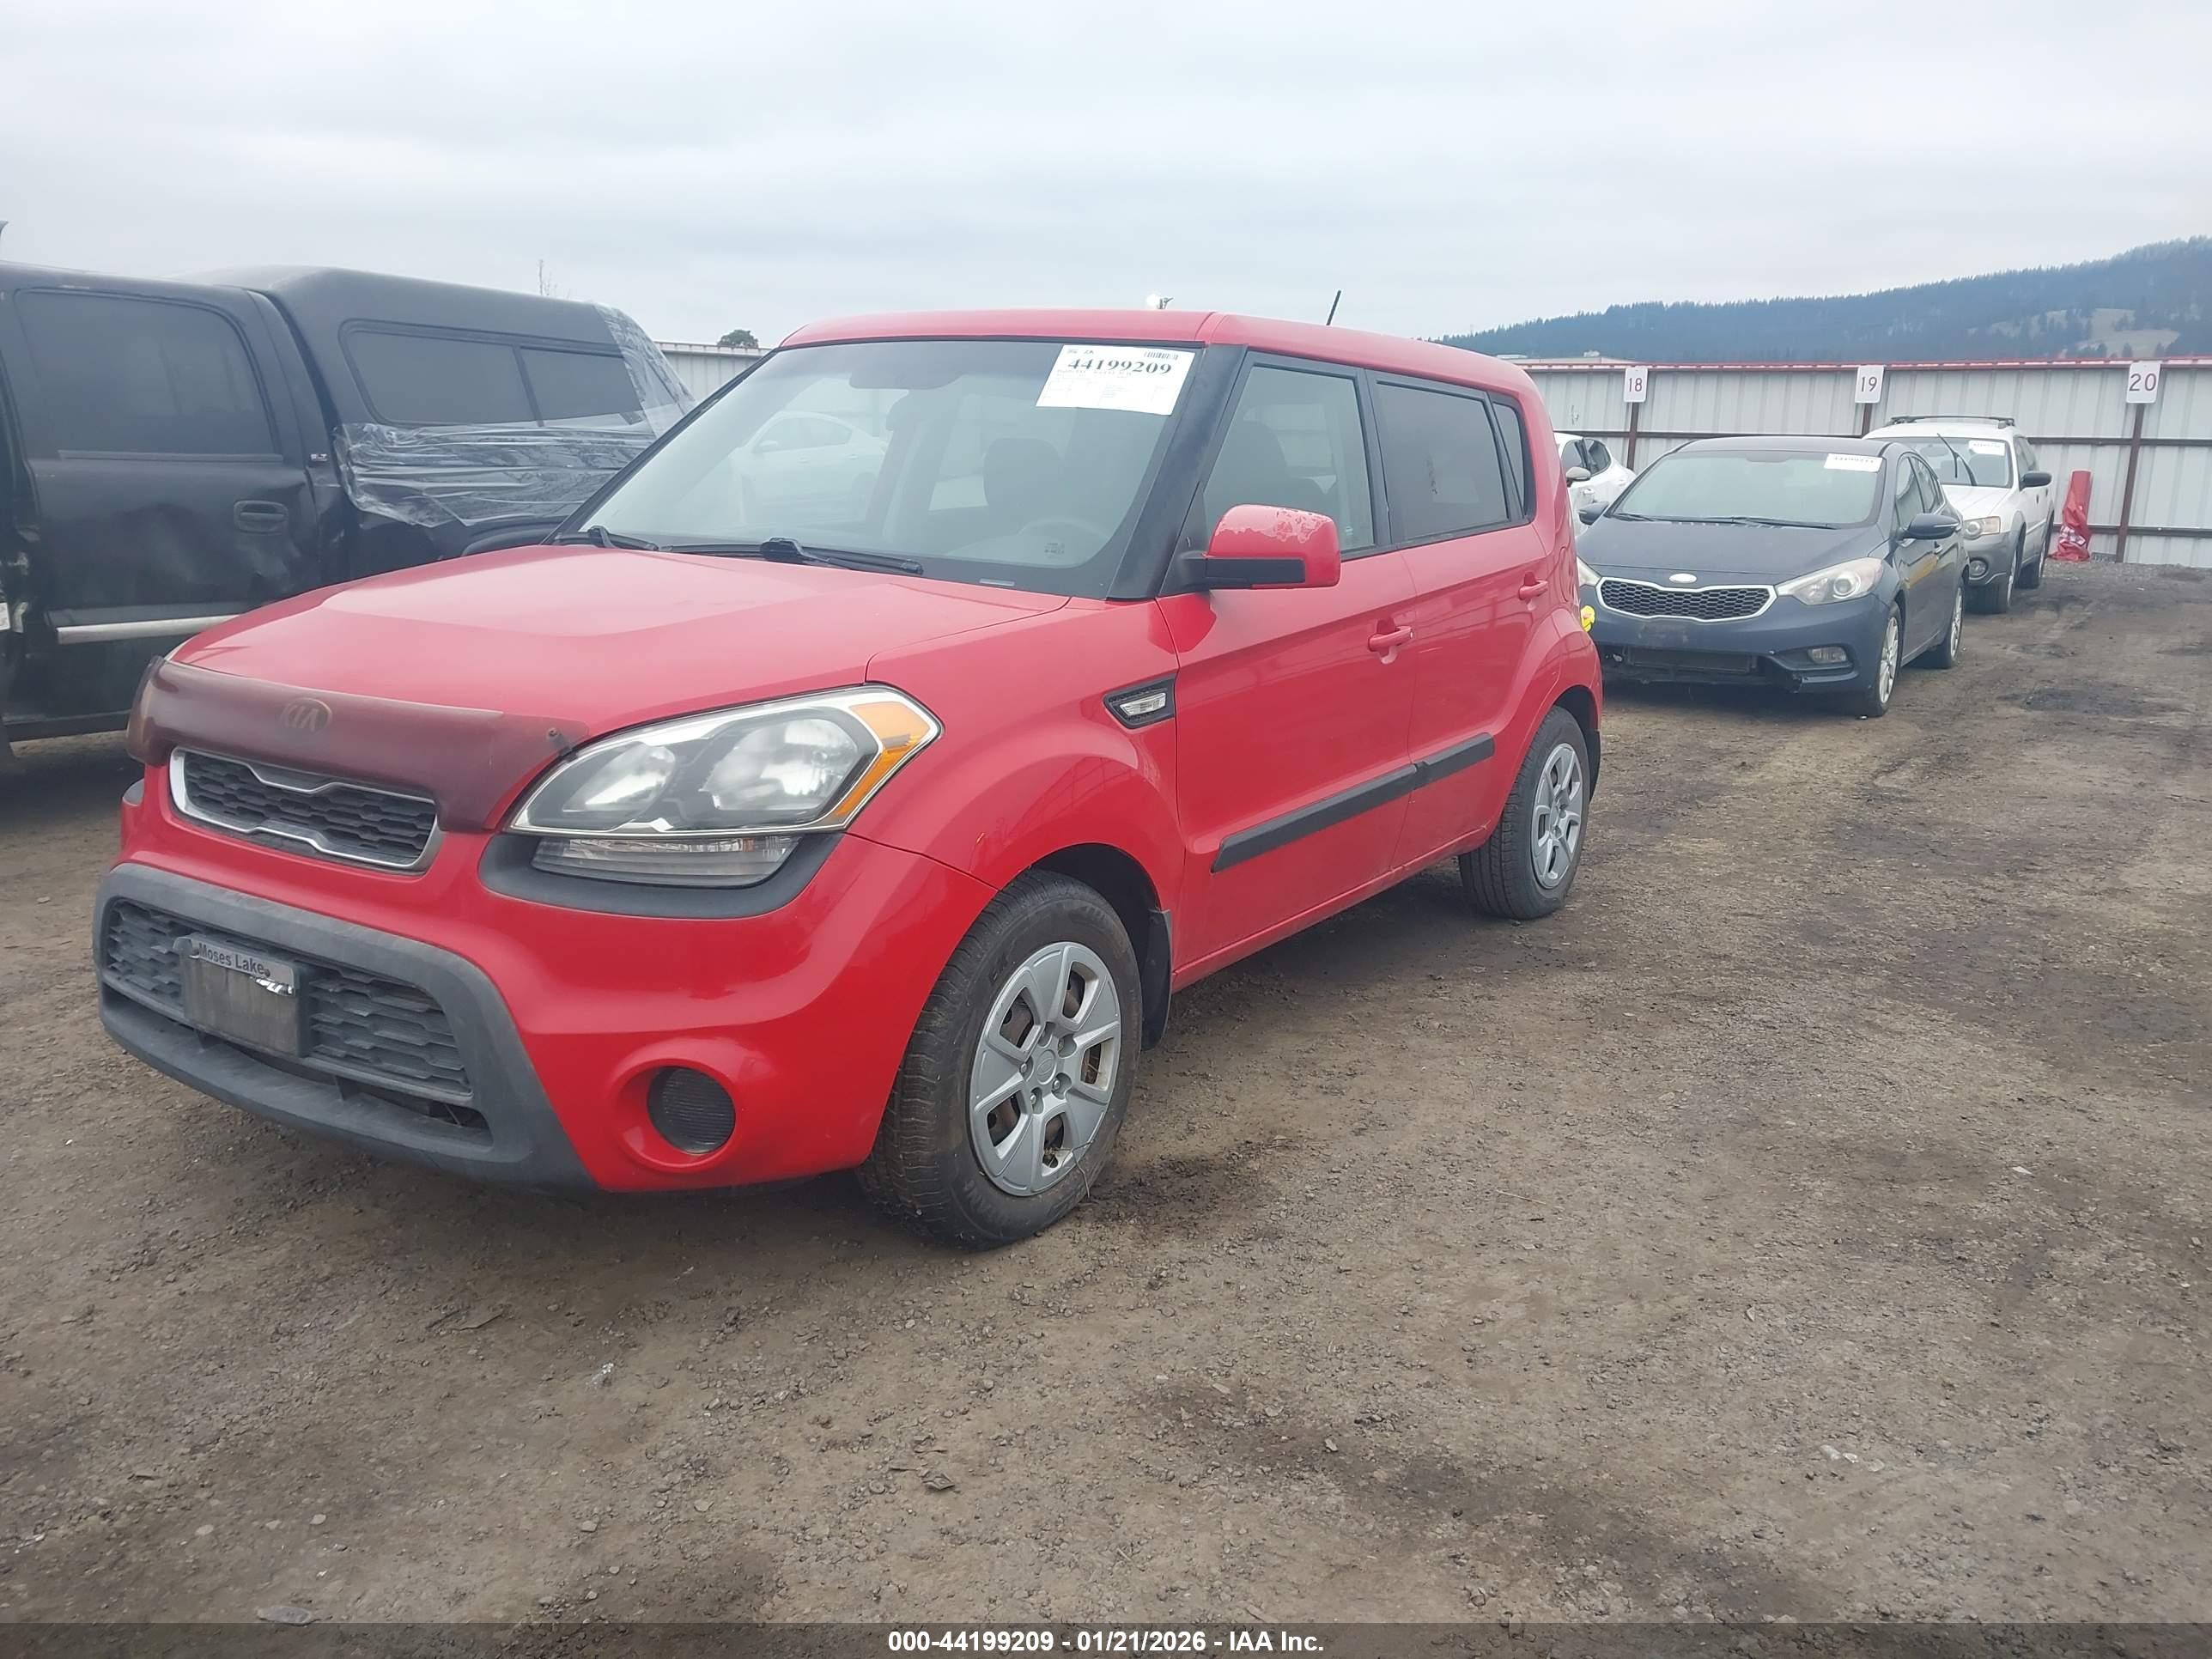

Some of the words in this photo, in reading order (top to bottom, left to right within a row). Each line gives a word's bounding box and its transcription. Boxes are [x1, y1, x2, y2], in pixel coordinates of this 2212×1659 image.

[1067, 358, 1172, 374] 44199209
[1629, 377, 1643, 392] 18
[1861, 376, 1878, 392] 19
[2129, 373, 2157, 392] 20
[284, 702, 321, 732] KIA
[198, 942, 232, 967] Moses
[234, 953, 265, 975] Lake
